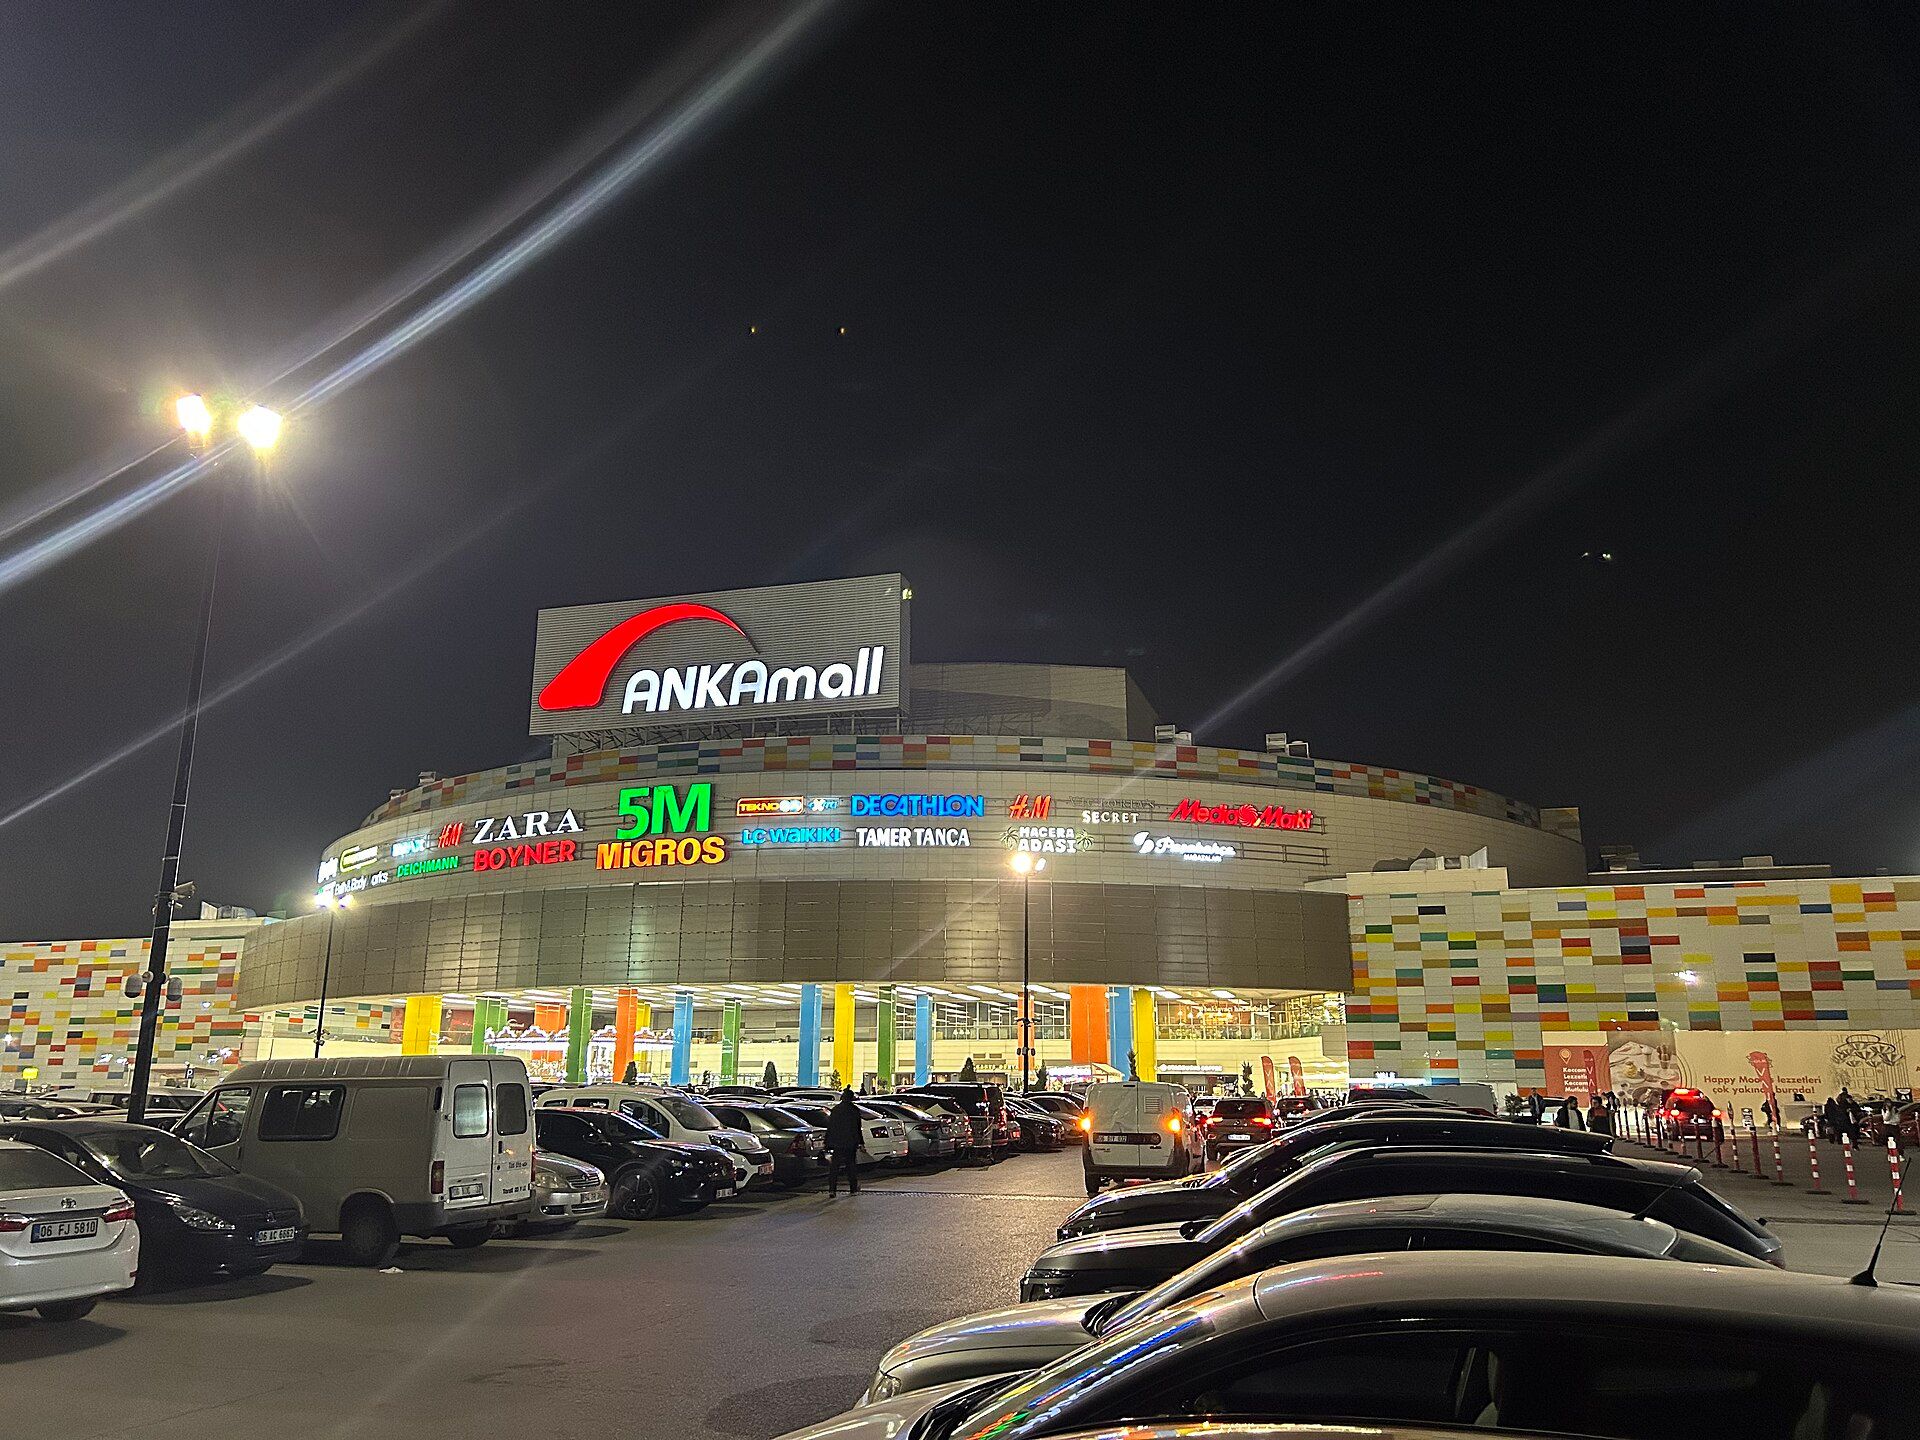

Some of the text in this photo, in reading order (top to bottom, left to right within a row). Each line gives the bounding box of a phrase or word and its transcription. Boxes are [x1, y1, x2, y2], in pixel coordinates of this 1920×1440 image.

[621, 645, 885, 715] ANKAmall
[616, 783, 712, 840] 5M
[851, 794, 985, 817] DECATHLON
[1009, 794, 1052, 821] H&M
[1081, 809, 1140, 824] SECRET
[1168, 796, 1314, 831] Media Markt
[438, 822, 464, 848] H&M
[472, 808, 584, 845] ZARA
[742, 829, 767, 844] LC
[855, 827, 971, 847] TAMER TANCA
[1019, 826, 1076, 838] MACERA
[473, 839, 577, 872] BOYNER
[595, 835, 727, 871] MiGROS
[1017, 838, 1078, 854] ADASI
[396, 856, 460, 878] DEICHMANN
[186, 1069, 193, 1079] P
[1703, 1075, 1735, 1085] Happy
[1777, 1075, 1821, 1084] lezzetleri
[1712, 1085, 1729, 1094] çok
[1775, 1085, 1815, 1094] burada!
[41, 1221, 95, 1237] 06 FJ 5810
